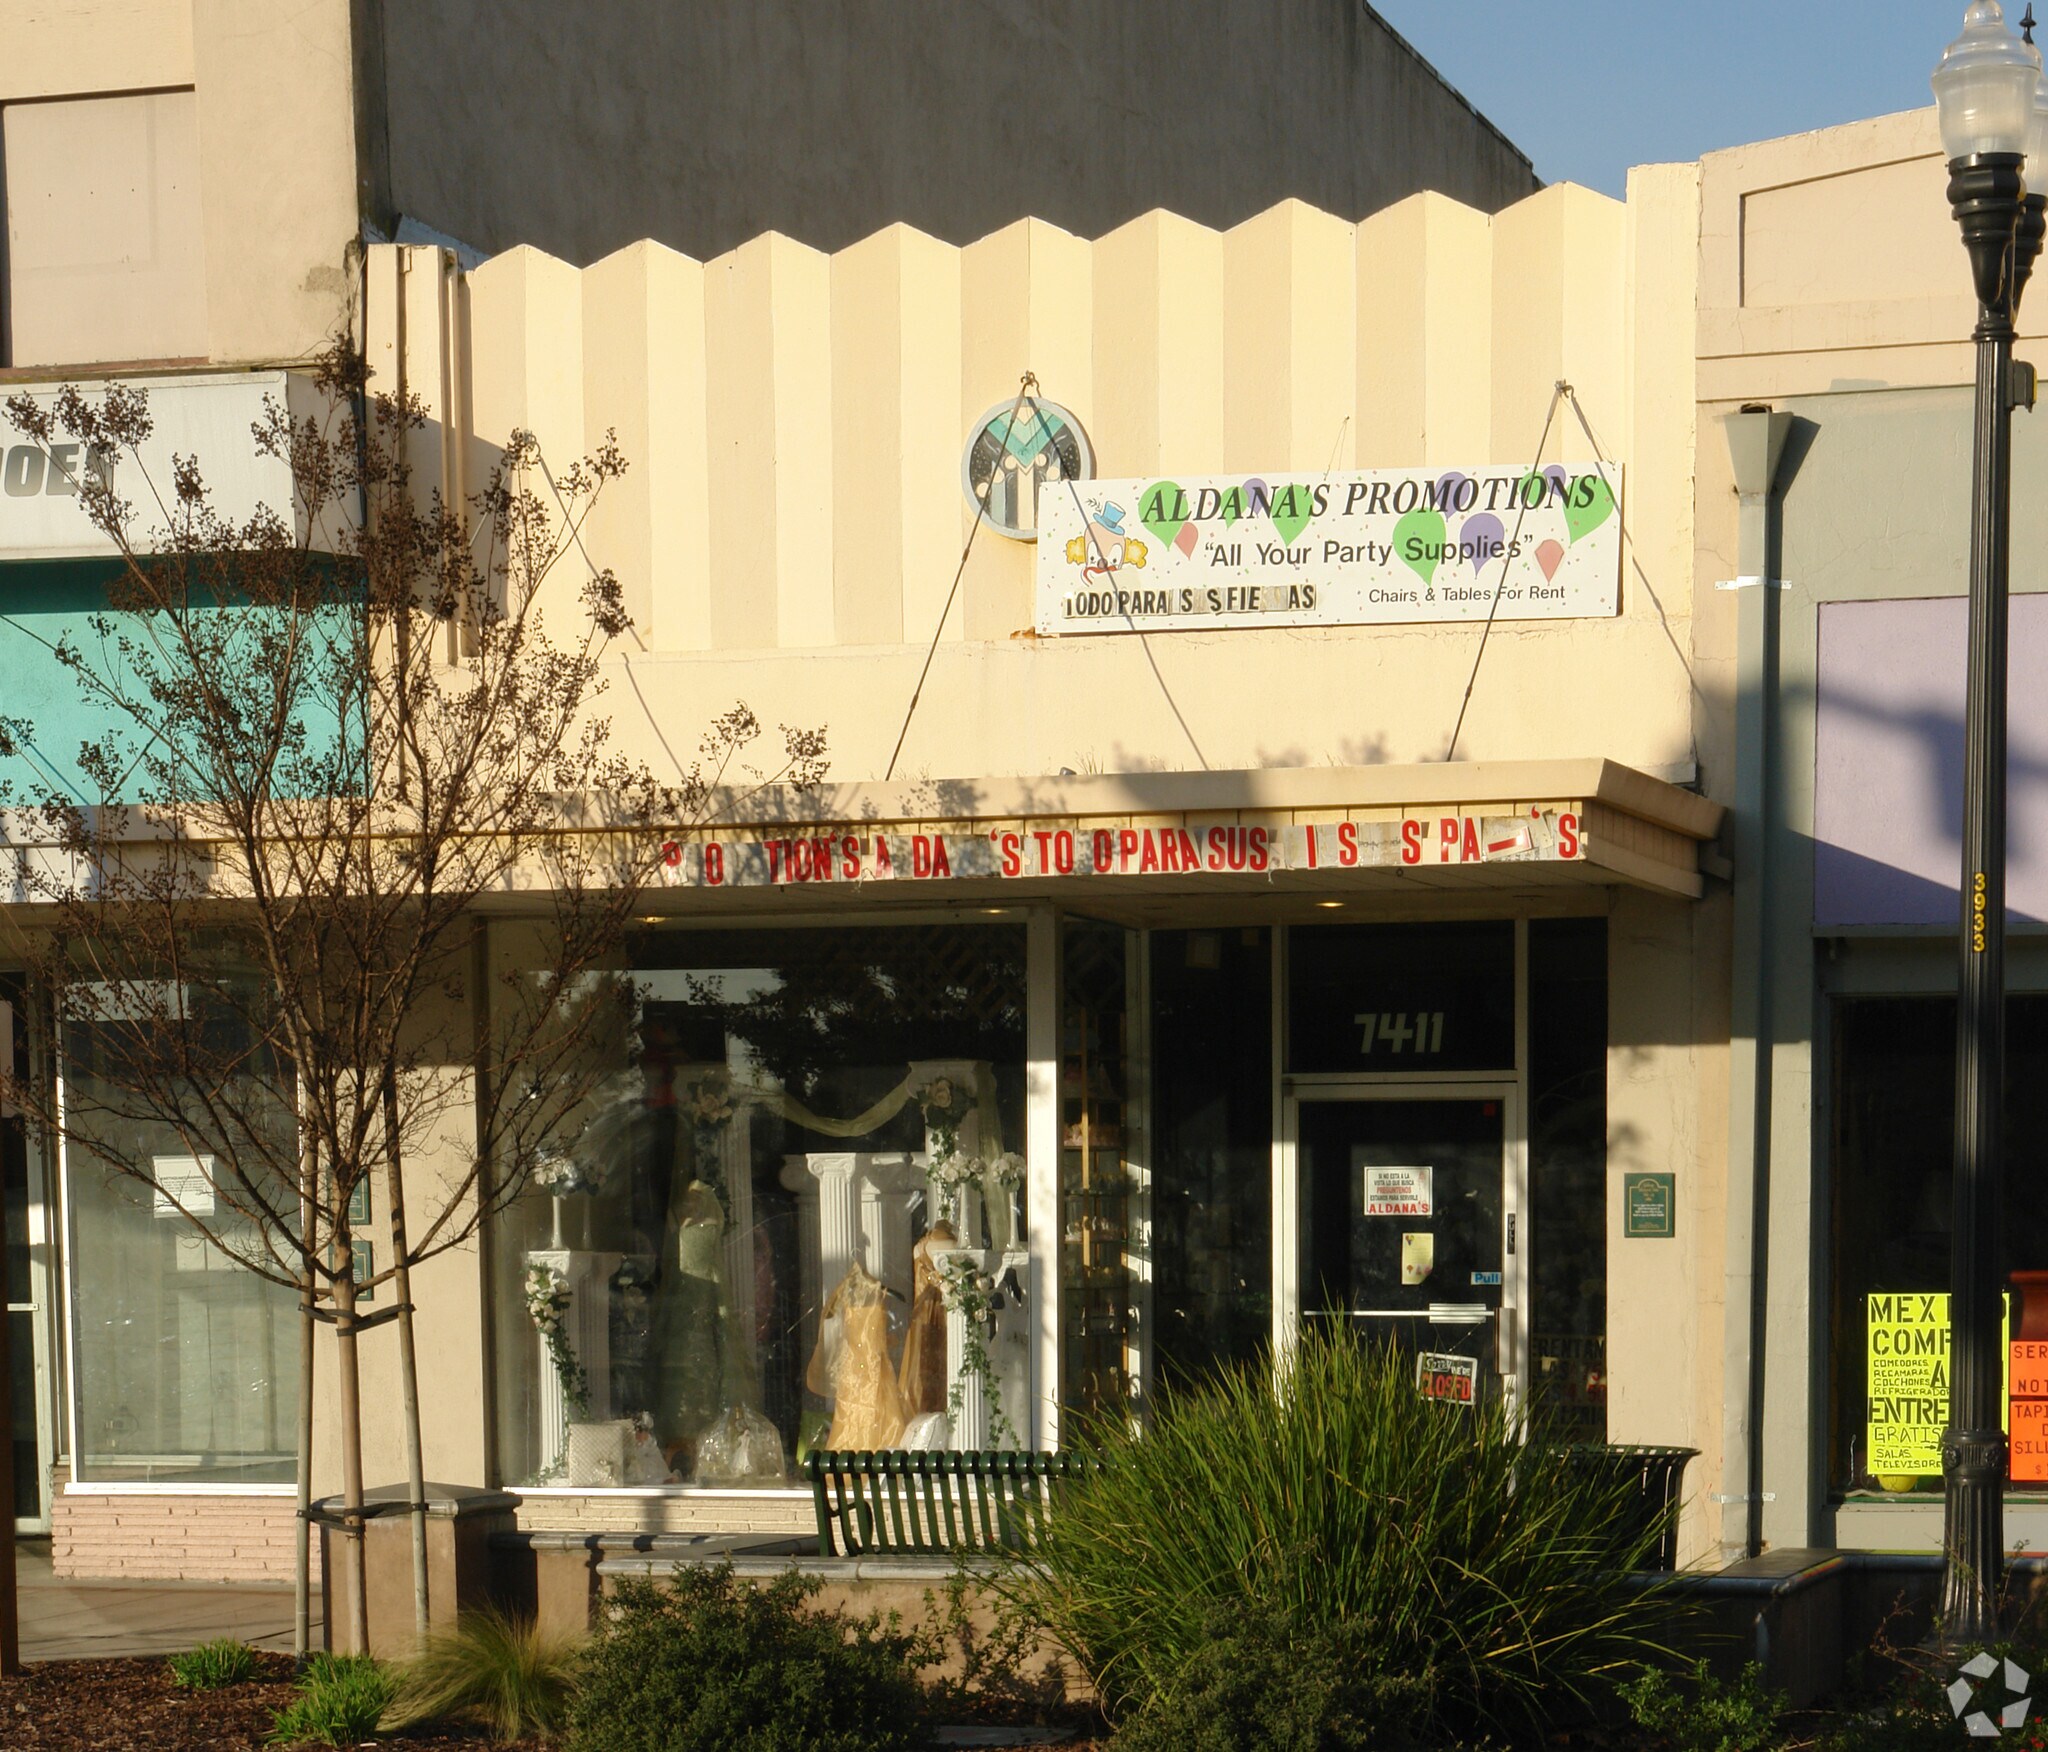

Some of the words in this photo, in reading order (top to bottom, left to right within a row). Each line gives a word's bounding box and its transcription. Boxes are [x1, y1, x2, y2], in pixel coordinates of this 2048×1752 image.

[0, 444, 115, 498] OES
[1141, 483, 1331, 523] ALDANA'S
[1342, 474, 1598, 515] PROMOTIONS
[1256, 542, 1312, 565] Your
[1324, 540, 1393, 567] Party
[1119, 590, 1168, 615] PARA
[1369, 588, 1418, 603] Chairs
[1425, 587, 1436, 601] &
[1442, 587, 1491, 601] Tables
[1498, 586, 1523, 600] For
[1529, 586, 1566, 600] Rent
[1120, 828, 1202, 873] PARA
[1208, 826, 1268, 871] SUS
[1973, 872, 1986, 952] 3933
[1354, 1012, 1444, 1054] 7411
[1369, 1201, 1429, 1214] ALDANA'S
[1474, 1273, 1499, 1283] Pull
